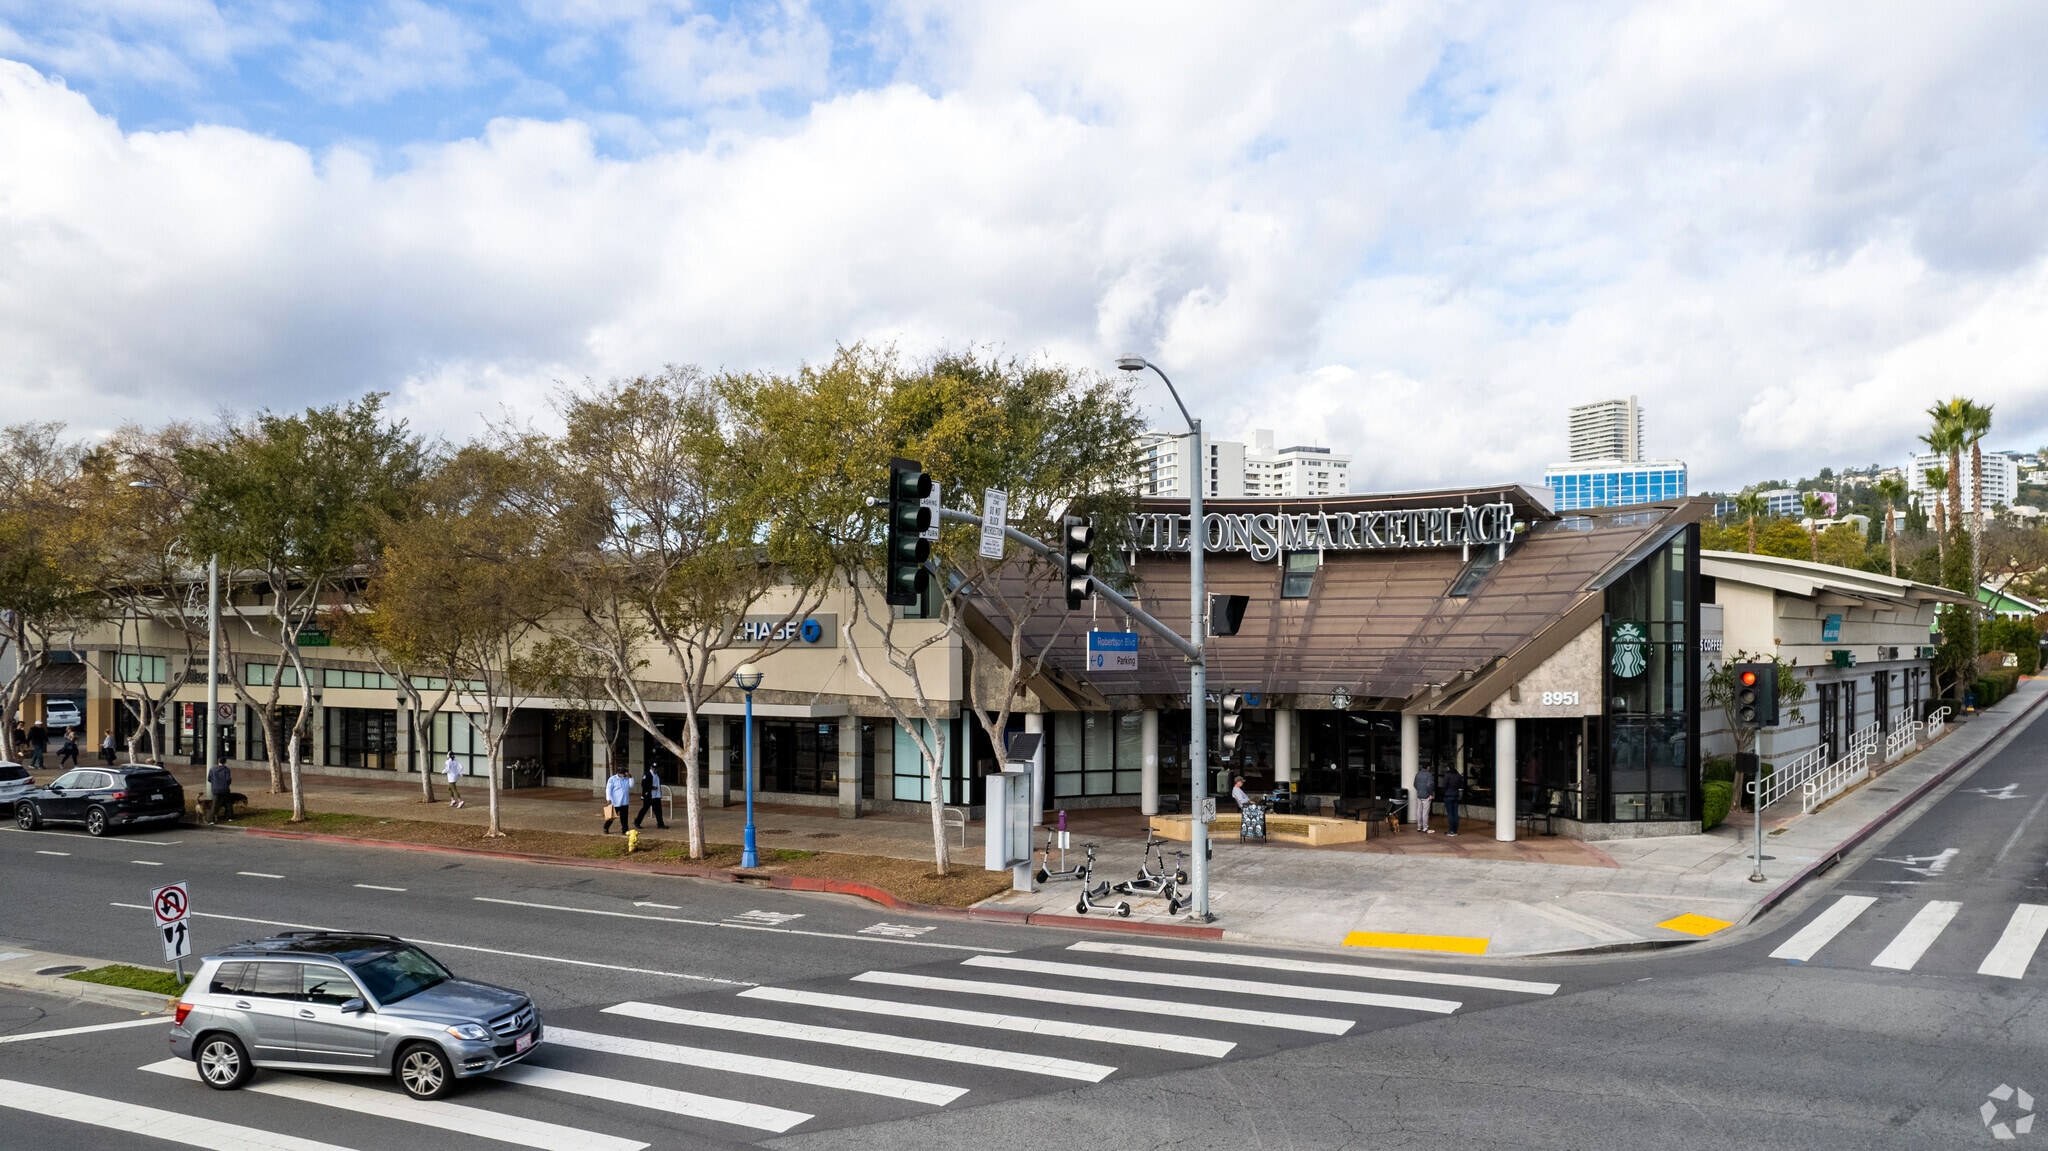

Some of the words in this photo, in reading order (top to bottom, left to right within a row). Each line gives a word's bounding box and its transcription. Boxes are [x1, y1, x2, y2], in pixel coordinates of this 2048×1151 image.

[1279, 503, 1514, 550] MARKETPLACE
[1097, 637, 1124, 647] Robertson
[1124, 637, 1136, 647] Blvd
[1116, 656, 1136, 667] Parking
[1542, 691, 1579, 706] 8951
